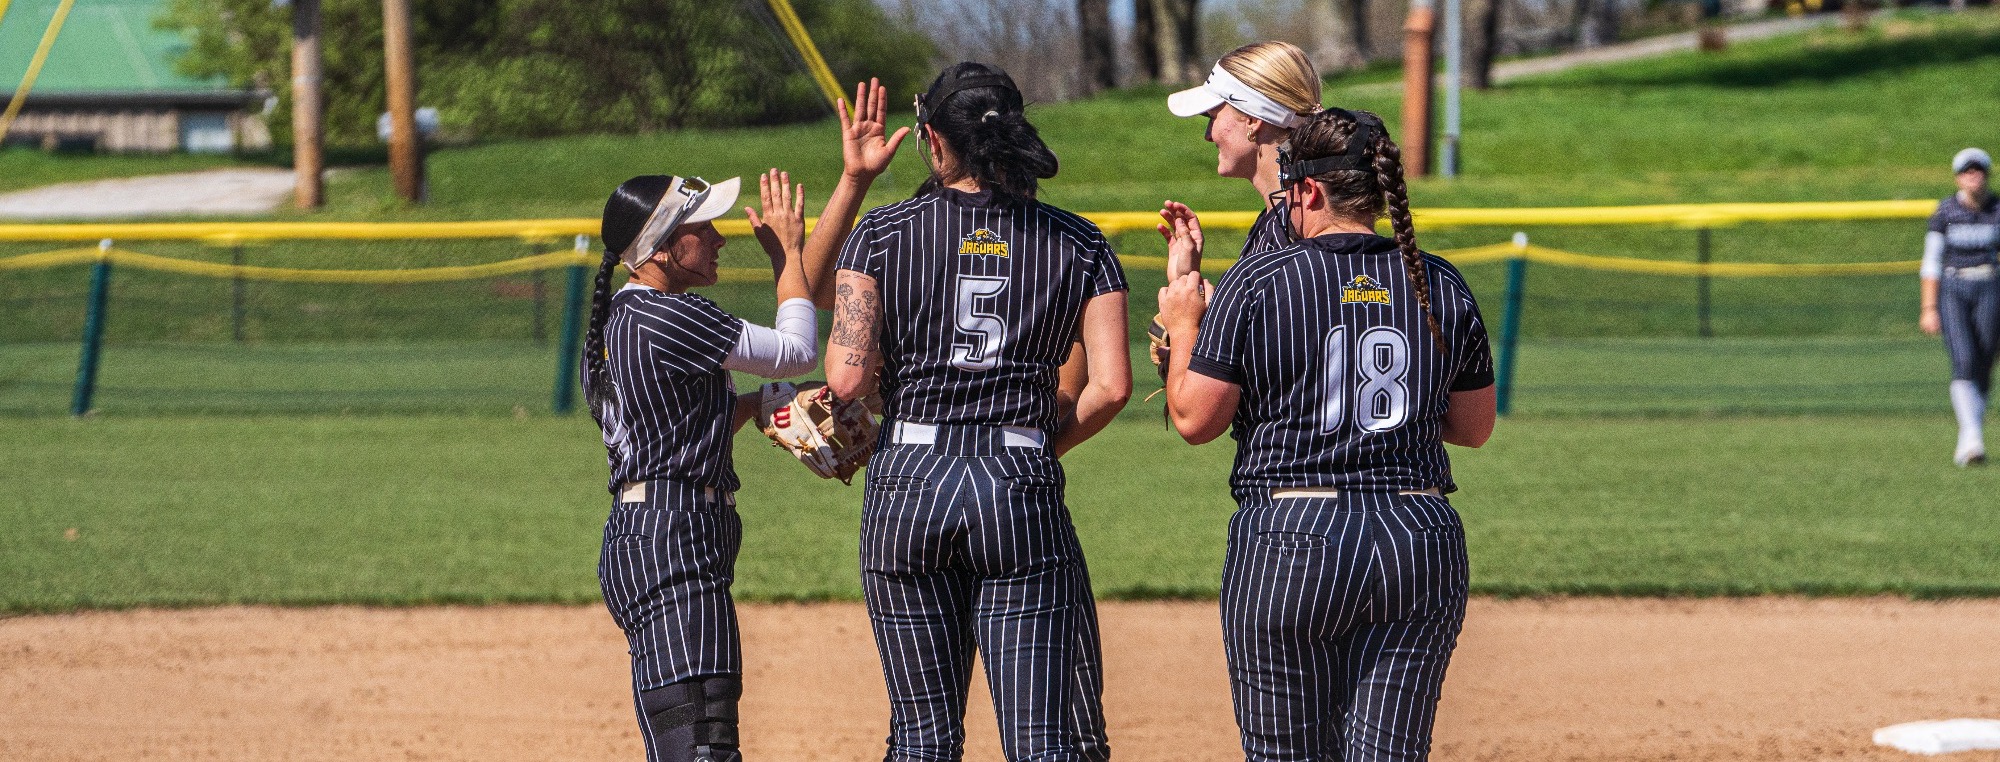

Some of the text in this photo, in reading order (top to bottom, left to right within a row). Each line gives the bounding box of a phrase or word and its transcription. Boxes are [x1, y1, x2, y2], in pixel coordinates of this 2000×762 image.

[959, 238, 1008, 257] JAGUARS
[1341, 288, 1391, 304] JAGUARS
[947, 274, 1009, 372] 5
[845, 352, 867, 368] 224
[1320, 324, 1410, 435] 18
